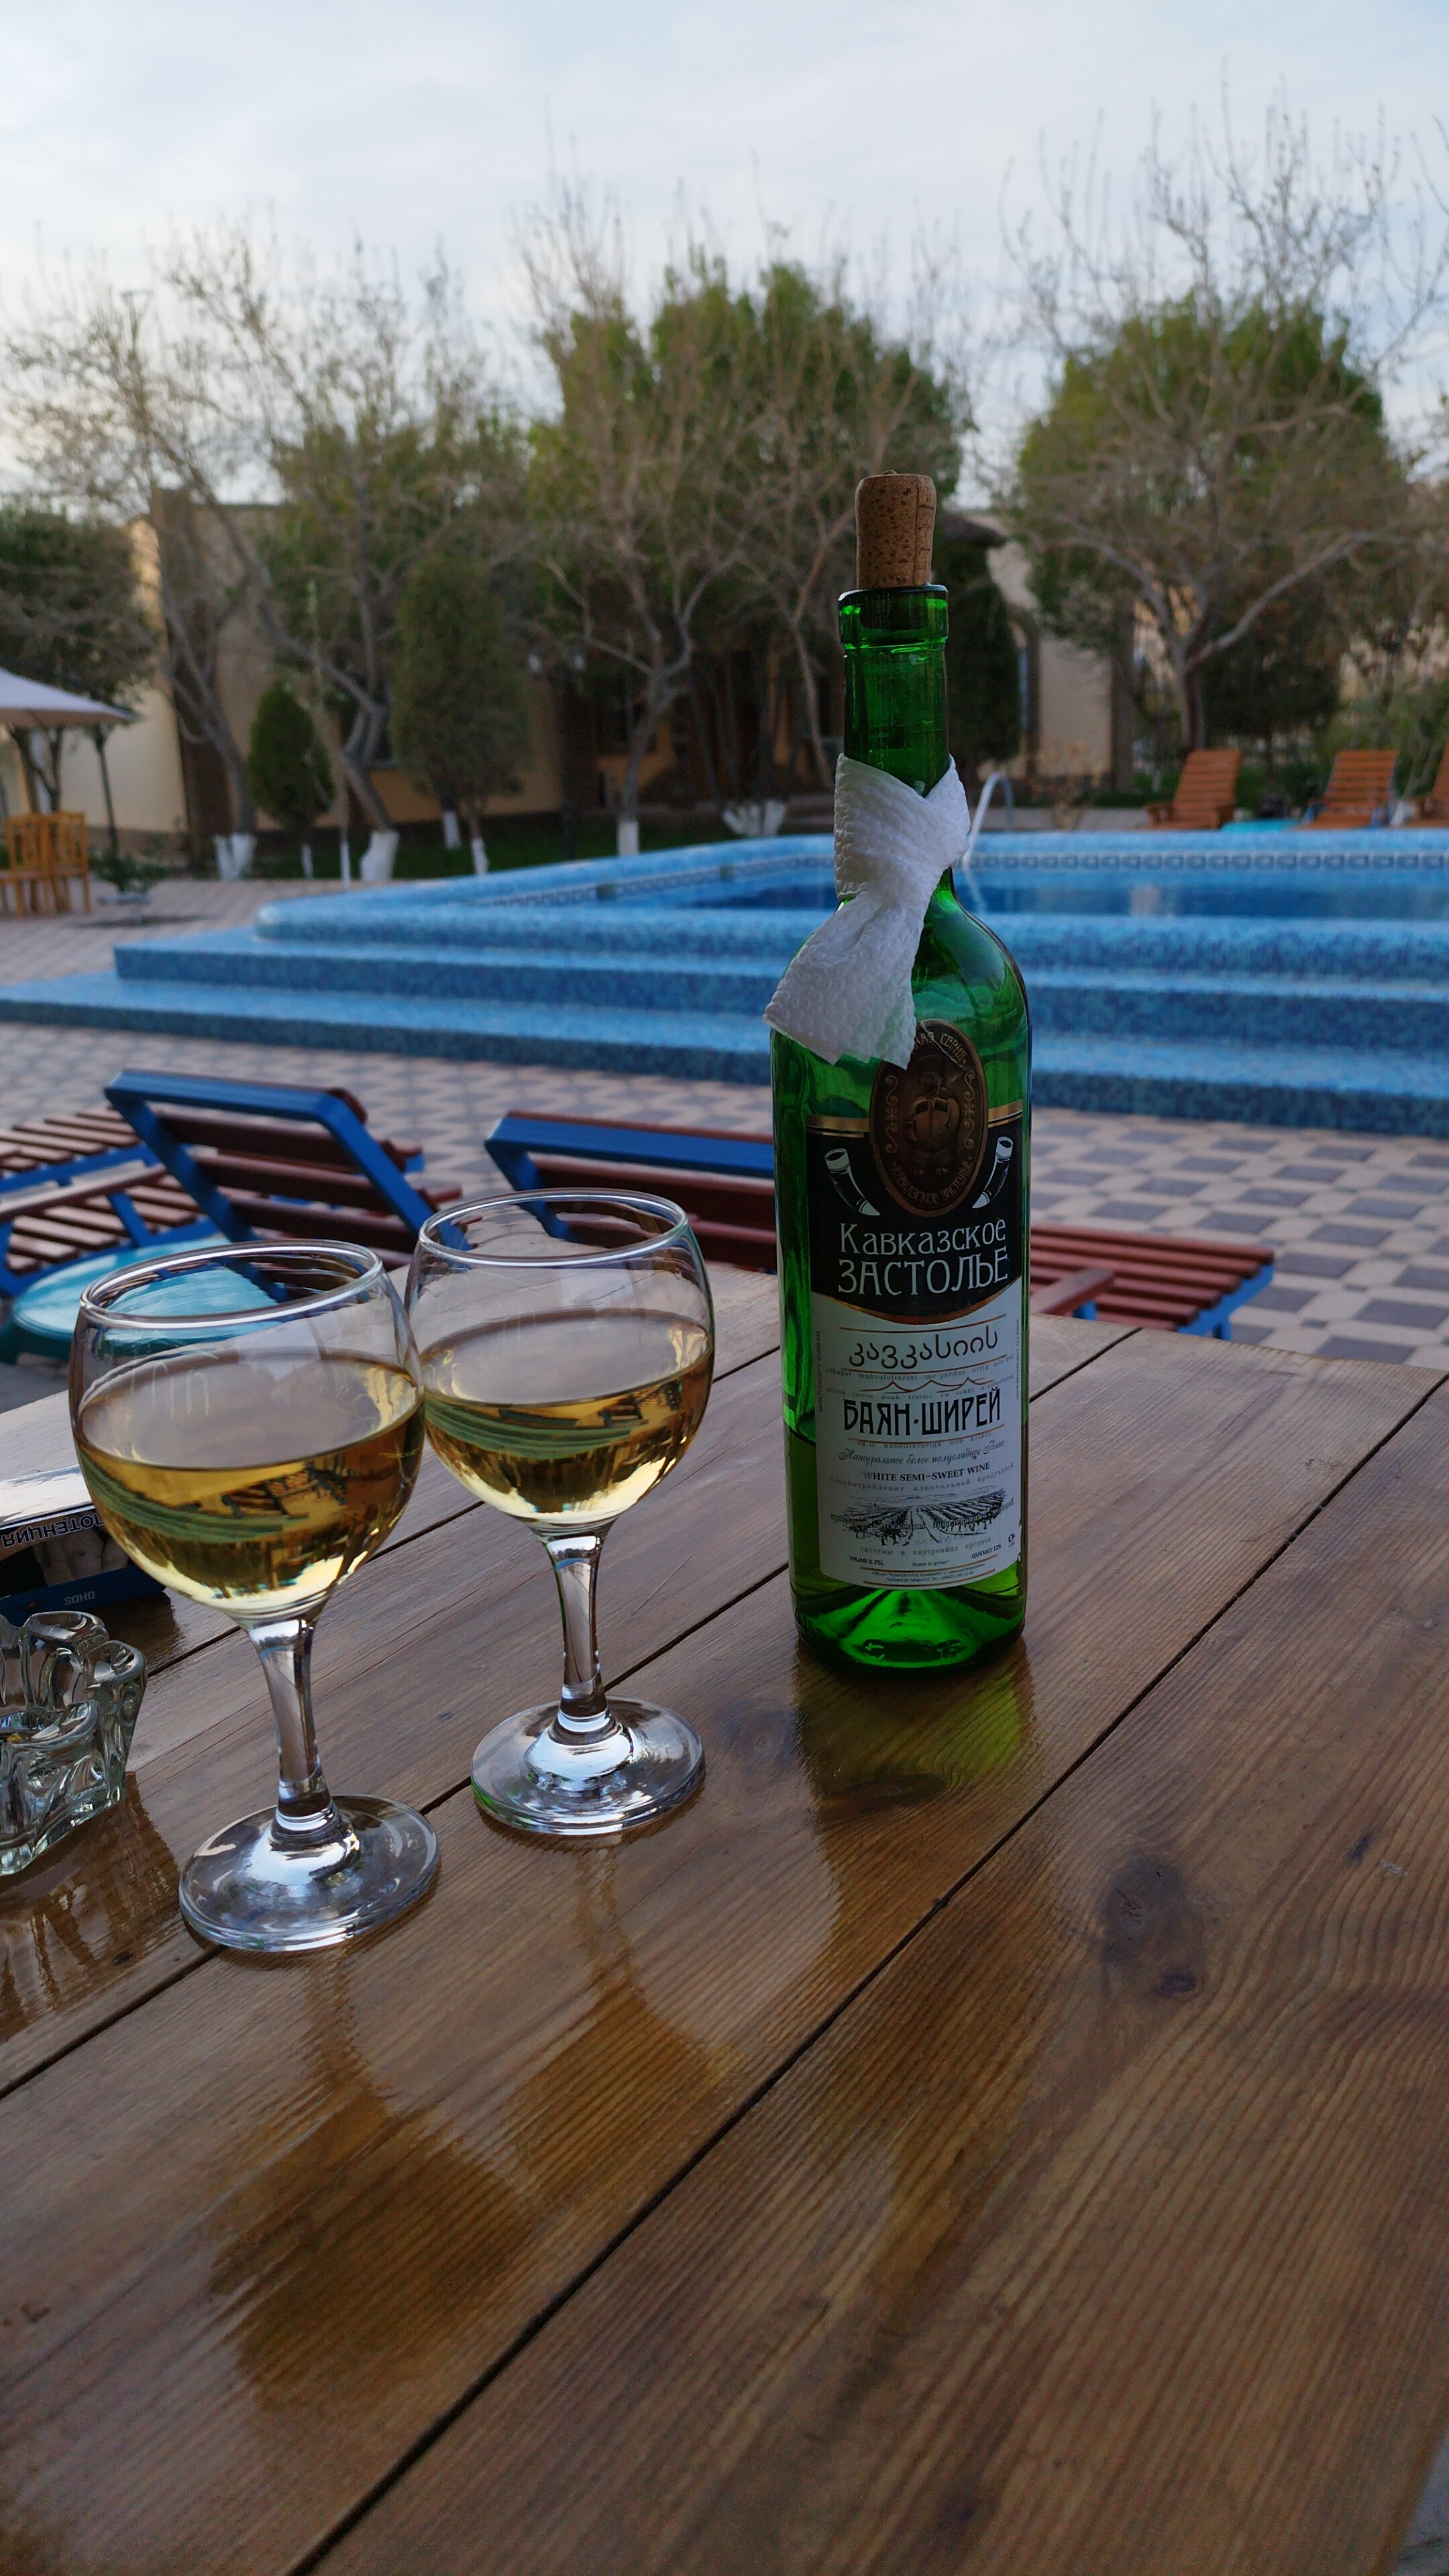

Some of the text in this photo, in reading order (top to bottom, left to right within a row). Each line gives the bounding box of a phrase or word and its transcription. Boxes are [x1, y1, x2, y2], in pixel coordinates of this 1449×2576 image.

[840, 1218, 1006, 1255] Кавказское
[838, 1246, 1009, 1296] ЗАСТОЛЬЕ
[849, 1325, 998, 1370] კავკასიის
[863, 1471, 898, 1481] WHITE
[967, 1461, 991, 1474] WINE
[849, 1555, 868, 1563] HAJMI
